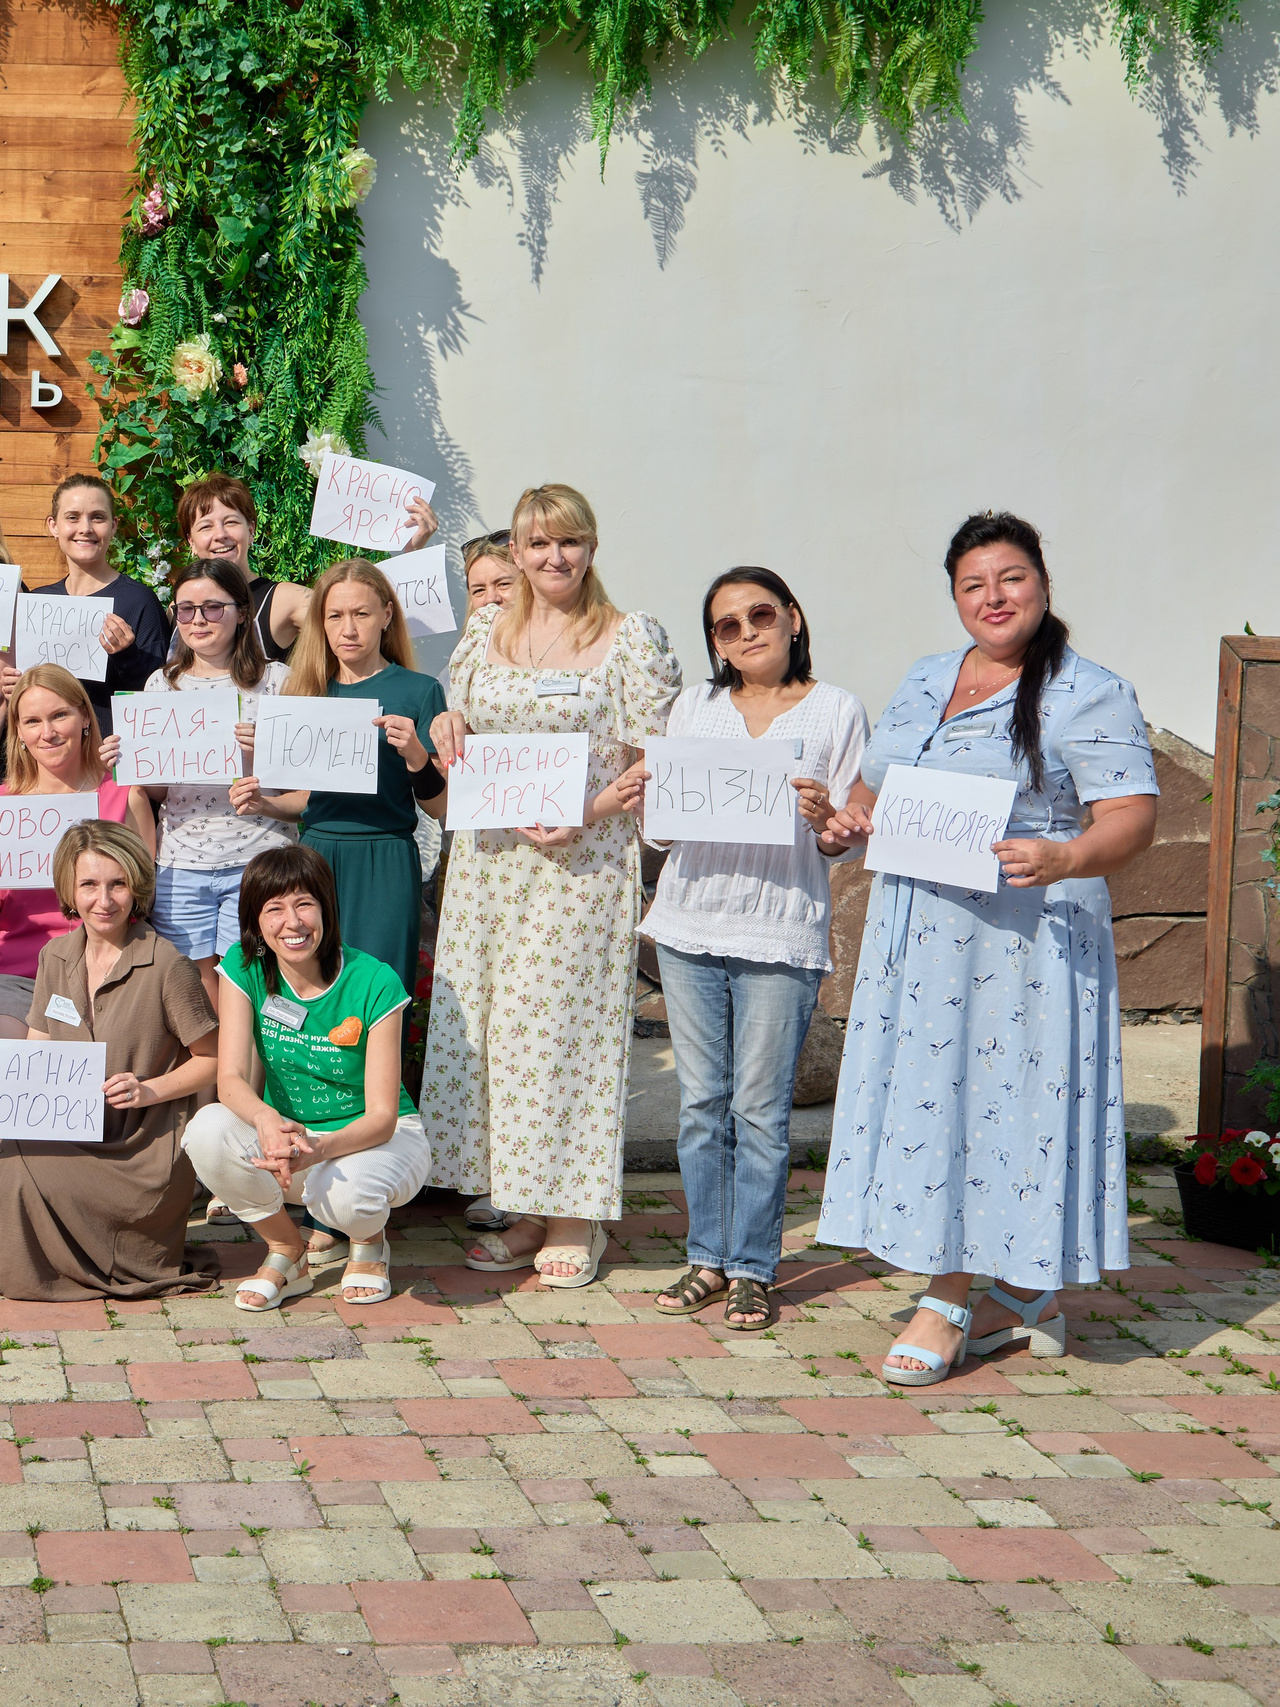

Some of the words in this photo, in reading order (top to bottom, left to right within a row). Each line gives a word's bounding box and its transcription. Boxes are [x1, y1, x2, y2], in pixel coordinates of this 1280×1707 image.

[325, 504, 405, 545] ЯРСК
[25, 600, 105, 637] КРАСНО
[37, 641, 100, 674] ЯРСК
[124, 707, 219, 739] ЧЕЛЯ-
[134, 741, 238, 779] БИНСК
[263, 713, 376, 775] ТЮМЕНЬ
[461, 745, 578, 775] КРАСНО-
[471, 780, 565, 819] ЯРСК
[656, 762, 792, 817] КЫЗЫЛ
[880, 794, 1007, 860] КРАСНОЯРСК
